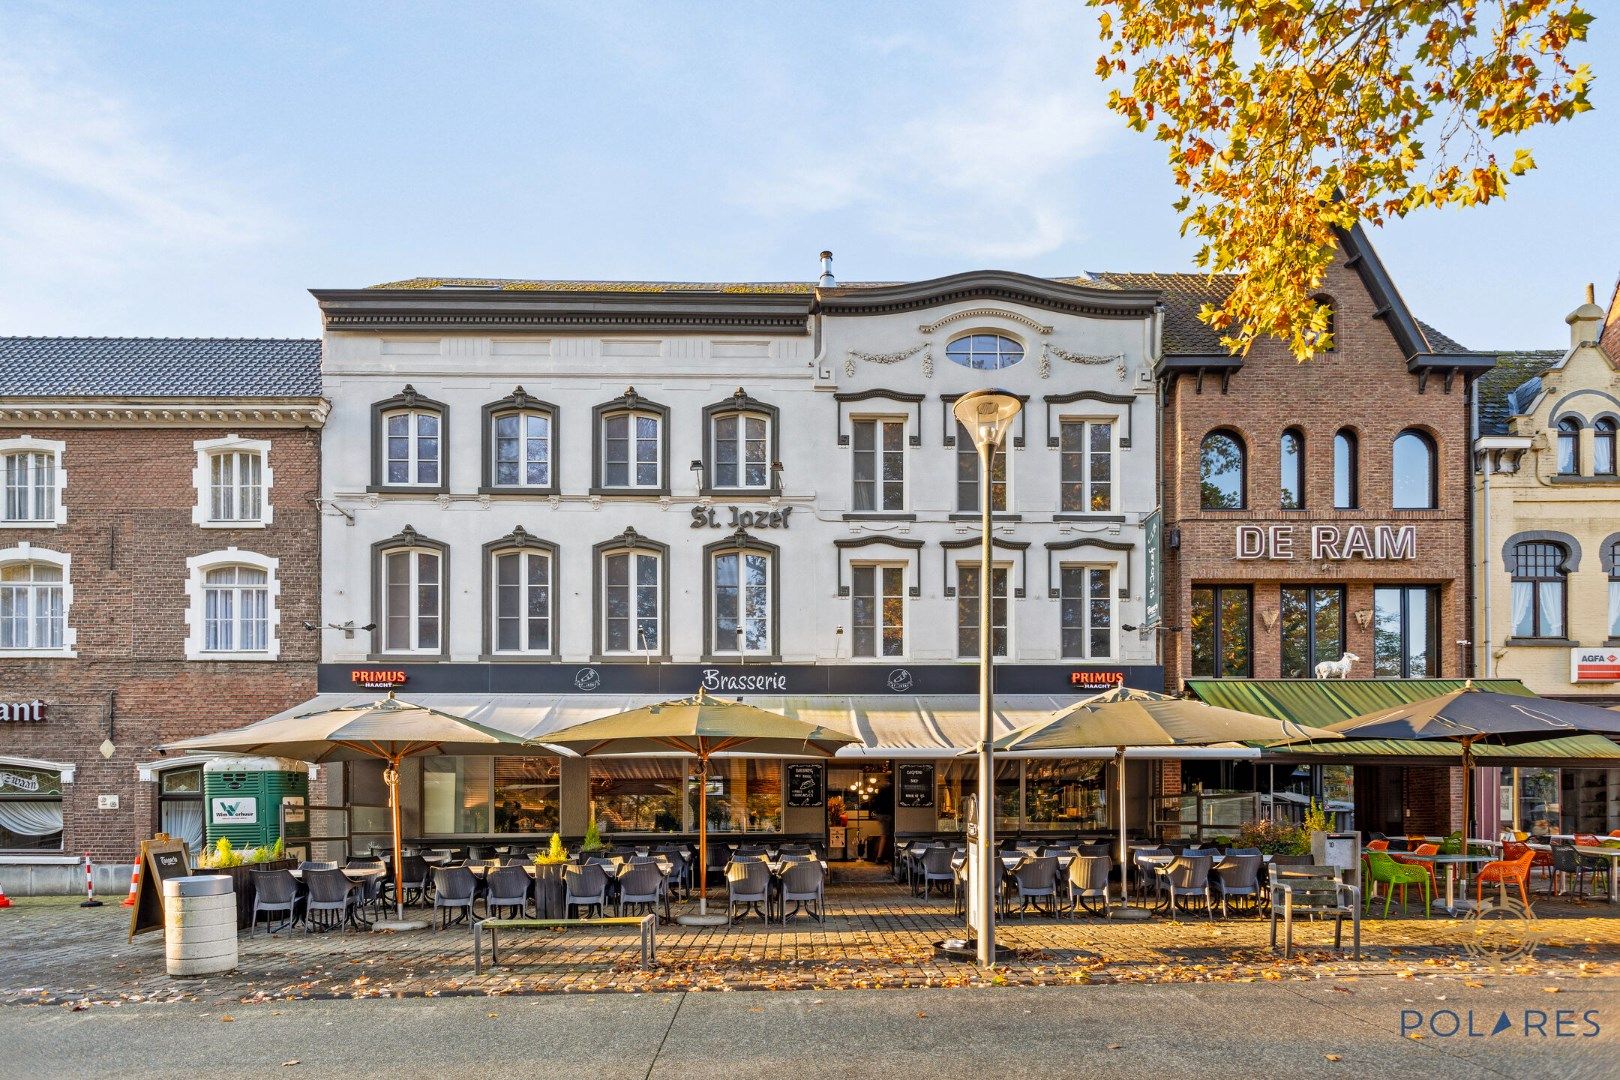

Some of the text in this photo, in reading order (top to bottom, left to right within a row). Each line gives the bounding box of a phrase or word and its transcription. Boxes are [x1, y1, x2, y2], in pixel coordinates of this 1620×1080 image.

[1236, 525, 1417, 560] DE RAM
[351, 670, 406, 682] PRIMUS
[702, 669, 787, 690] Brasserie
[1071, 671, 1124, 683] PRIMUS
